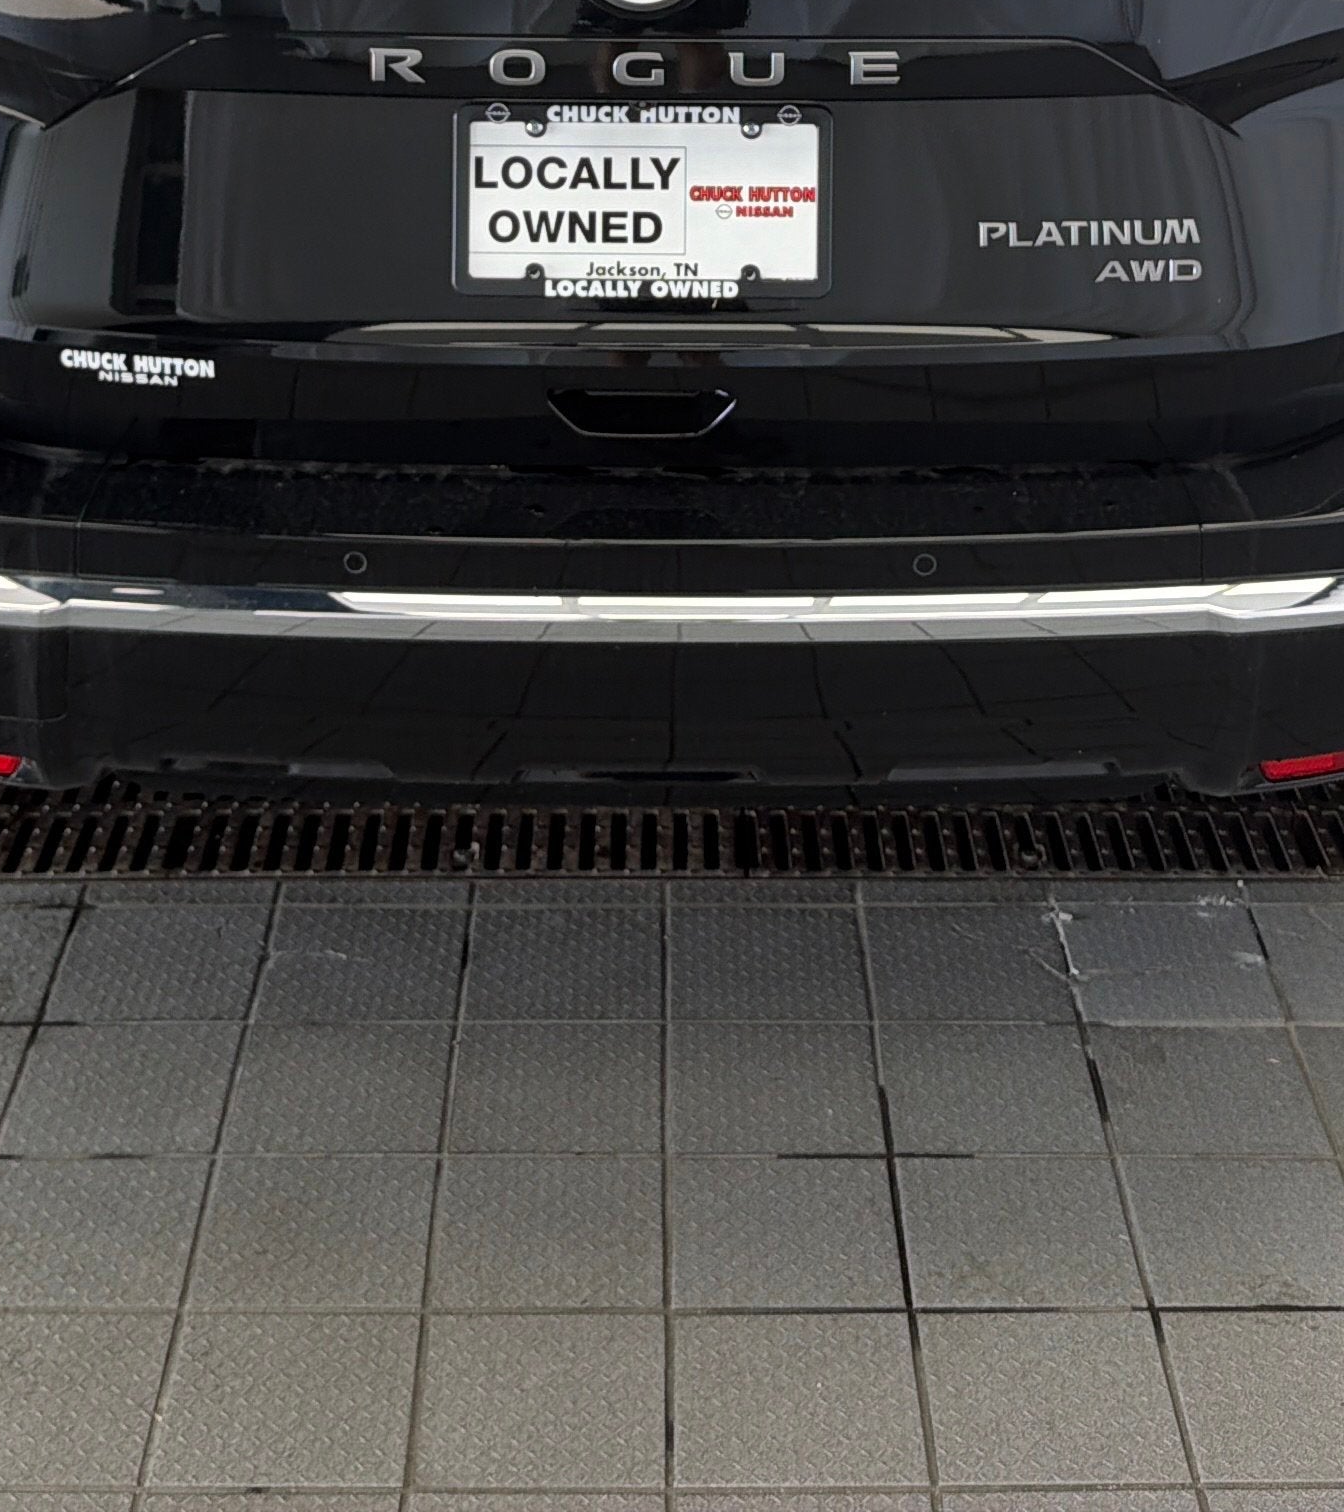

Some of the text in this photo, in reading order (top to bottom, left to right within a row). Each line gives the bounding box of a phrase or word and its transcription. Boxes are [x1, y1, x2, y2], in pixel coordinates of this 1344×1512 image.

[369, 46, 902, 87] ROGUE
[546, 105, 741, 124] CHUCK HUTTON
[473, 155, 681, 190] LOCALLY
[689, 185, 816, 203] CHUCK HUTTON
[735, 205, 794, 218] NISSAN
[488, 209, 663, 244] OWNED
[977, 218, 1201, 248] PLATINUM
[586, 260, 699, 280] Jackson, TN
[1094, 258, 1203, 283] AWD
[544, 279, 740, 299] LOCALLY OWNED
[60, 348, 216, 379] CHUCK HUTTON
[97, 370, 179, 387] NISSAN
